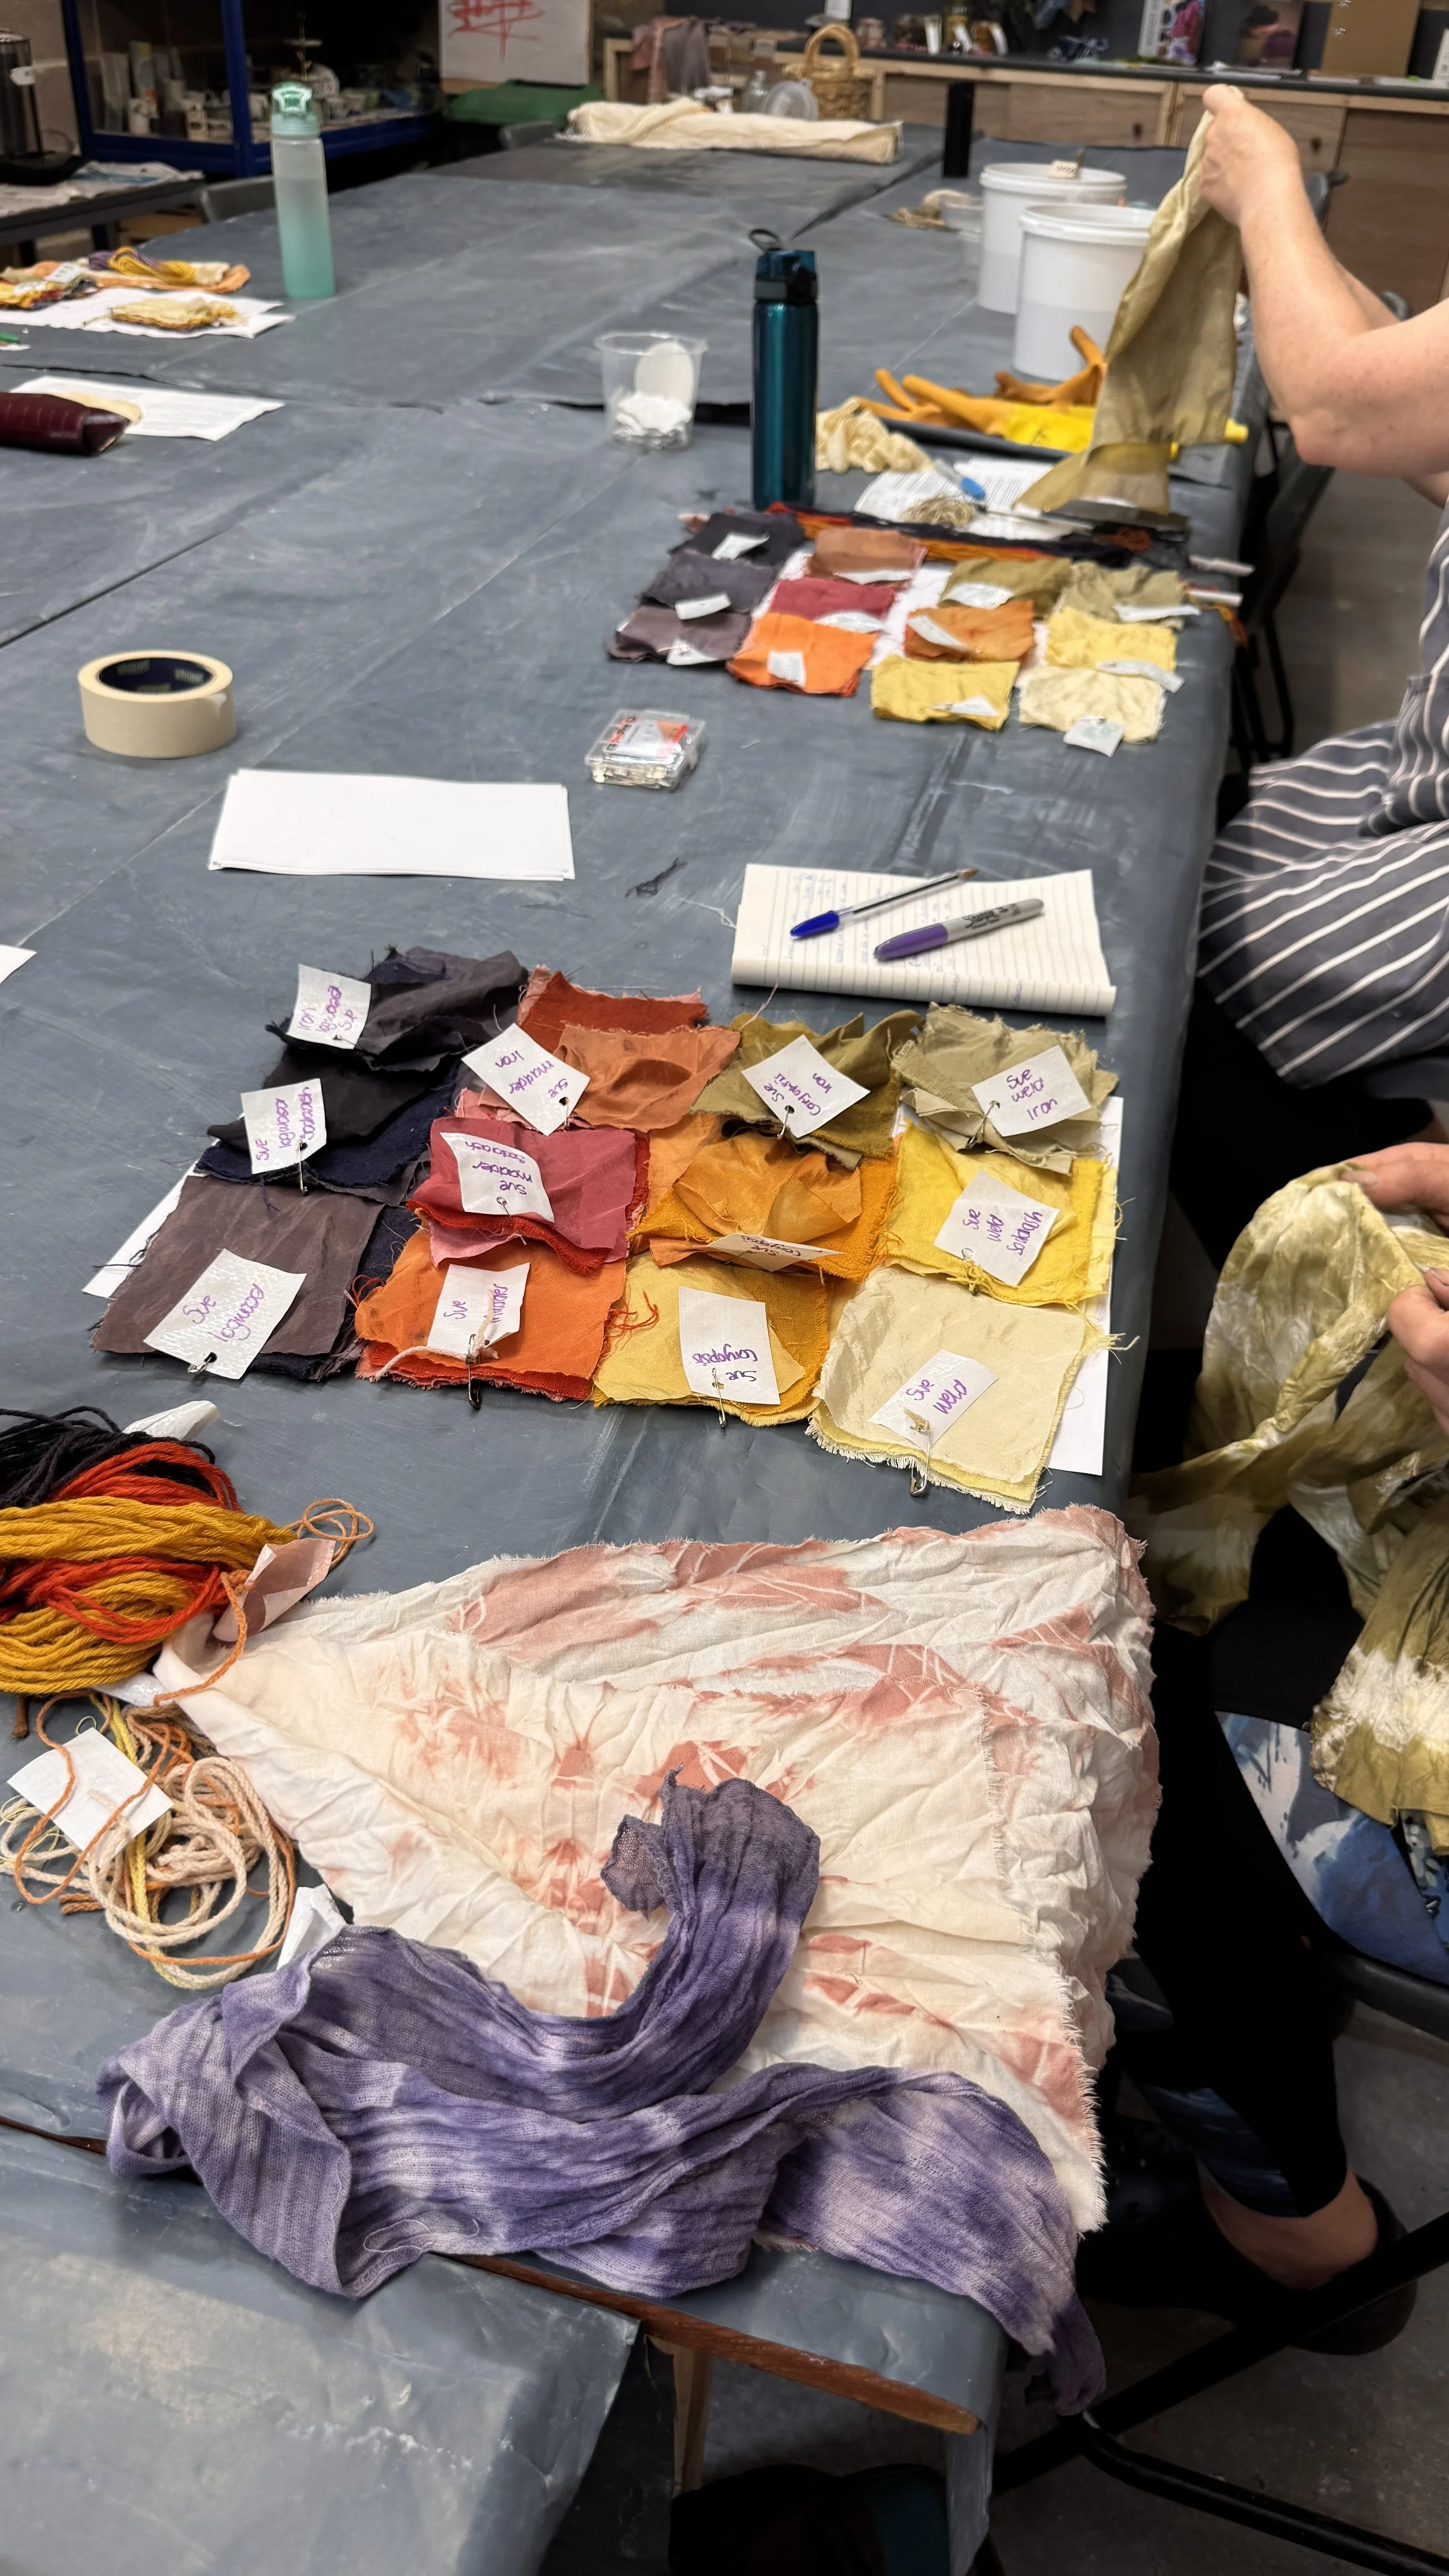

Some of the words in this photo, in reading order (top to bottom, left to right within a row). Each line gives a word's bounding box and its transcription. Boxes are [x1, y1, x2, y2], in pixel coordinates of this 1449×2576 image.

[297, 1007, 317, 1031] Iron
[494, 1050, 525, 1068] Iron
[508, 1060, 555, 1094] madder
[547, 1078, 569, 1098] Sue
[812, 1072, 833, 1094] Iron
[1006, 1069, 1033, 1090] Sue
[763, 1083, 784, 1102] Sue
[1011, 1077, 1044, 1103] weld
[1026, 1098, 1058, 1120] Iron
[254, 1138, 270, 1160] Sue
[472, 1160, 533, 1183] madder
[498, 1180, 527, 1195] Sue
[962, 1208, 981, 1230] Sue
[750, 1245, 780, 1257] Sue
[182, 1295, 216, 1324] Sue
[443, 1300, 468, 1320] Sue
[724, 1370, 758, 1382] Sue
[905, 1378, 935, 1401] Sue
